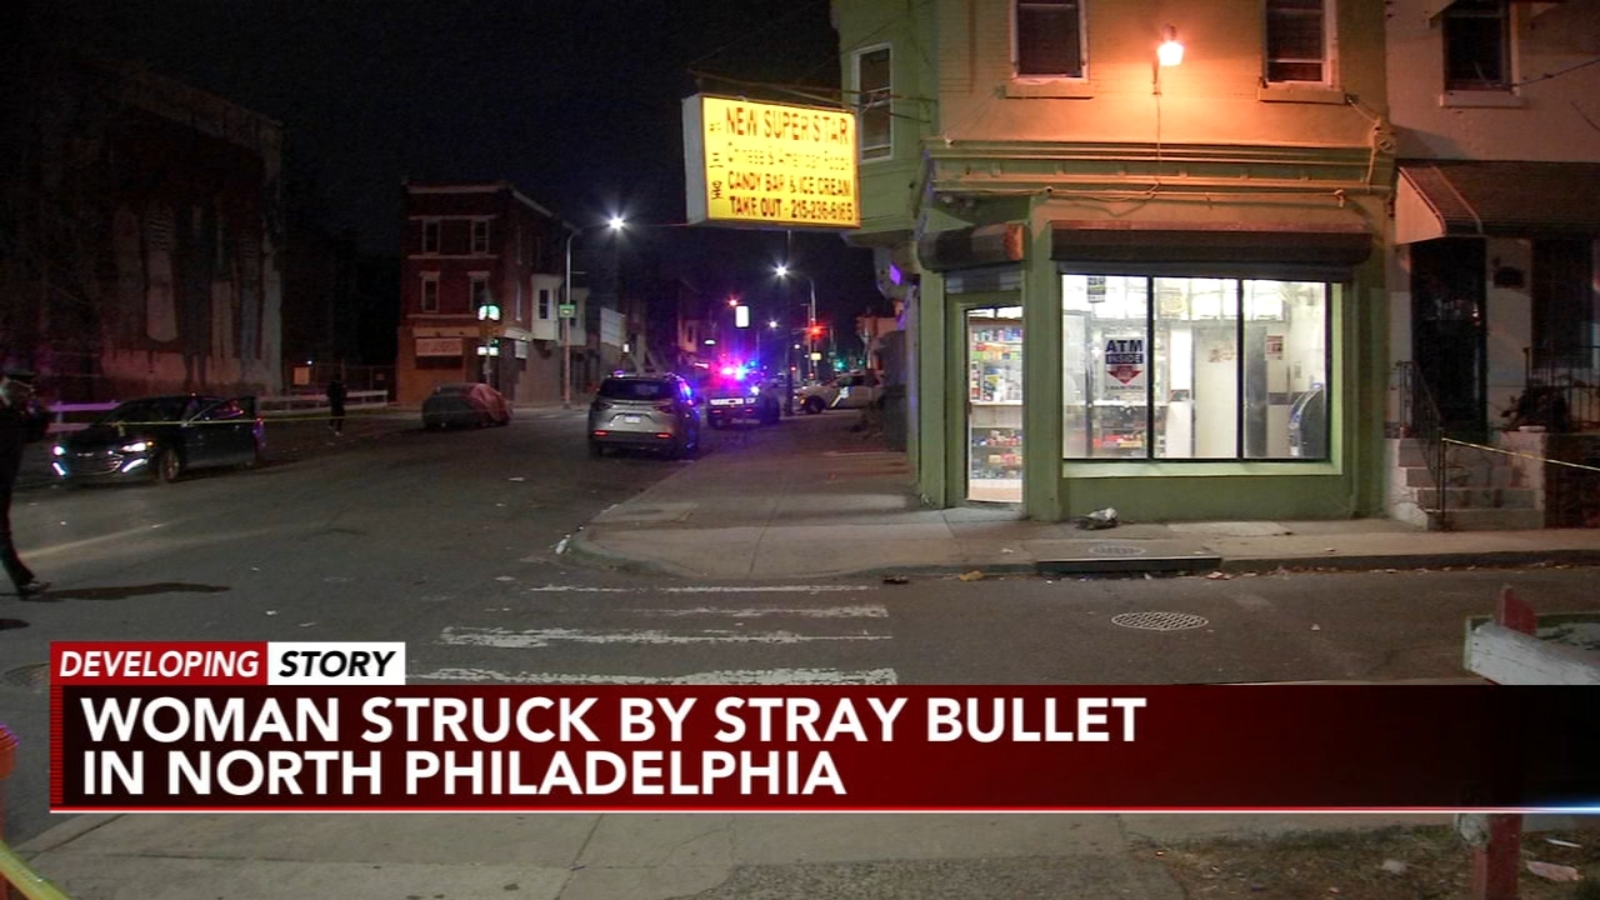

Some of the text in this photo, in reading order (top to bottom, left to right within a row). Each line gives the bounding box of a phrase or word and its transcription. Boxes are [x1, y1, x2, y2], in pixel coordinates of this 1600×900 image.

[726, 107, 849, 145] NEW SUPER STAR
[728, 170, 761, 192] CANDY
[799, 176, 814, 195] ICE
[729, 195, 757, 216] TAKE
[760, 197, 782, 218] OUT
[1105, 340, 1142, 352] ATM
